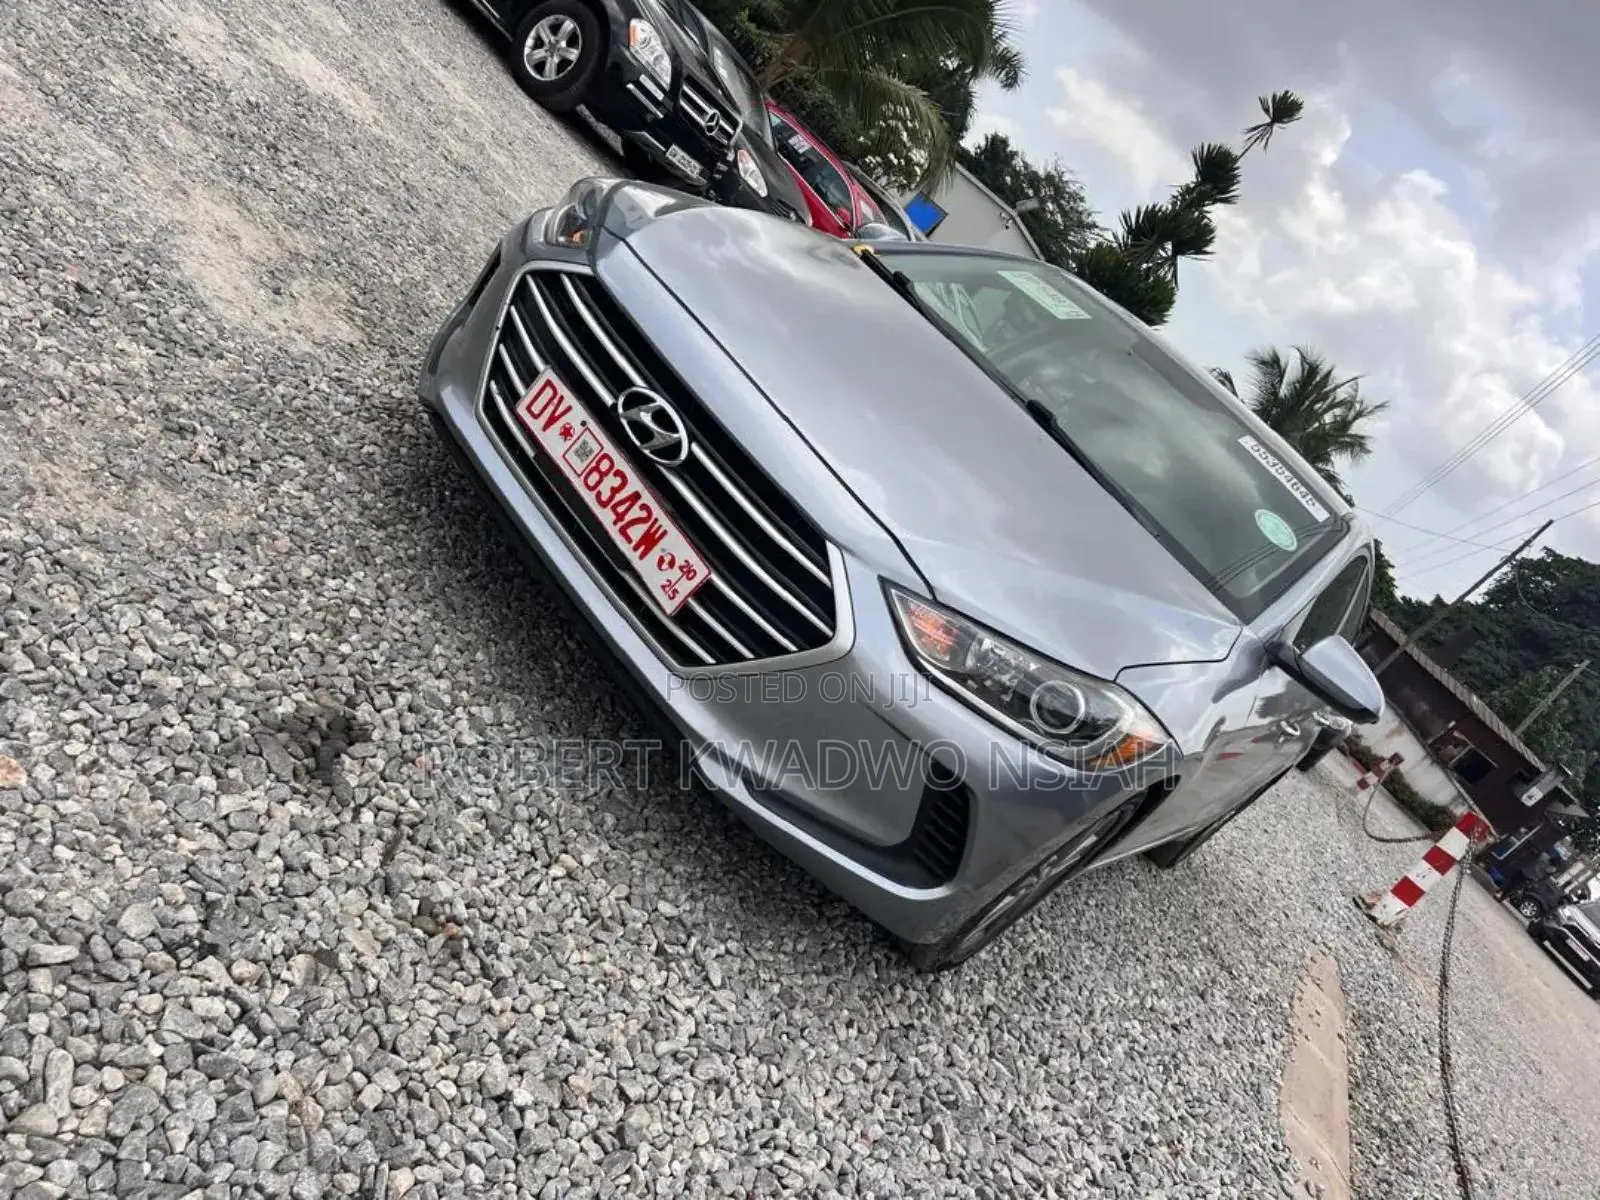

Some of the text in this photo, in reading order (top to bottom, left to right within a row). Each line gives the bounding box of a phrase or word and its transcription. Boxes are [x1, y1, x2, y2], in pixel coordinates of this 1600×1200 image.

[525, 378, 668, 560] DV 8342W
[660, 579, 680, 600] 25
